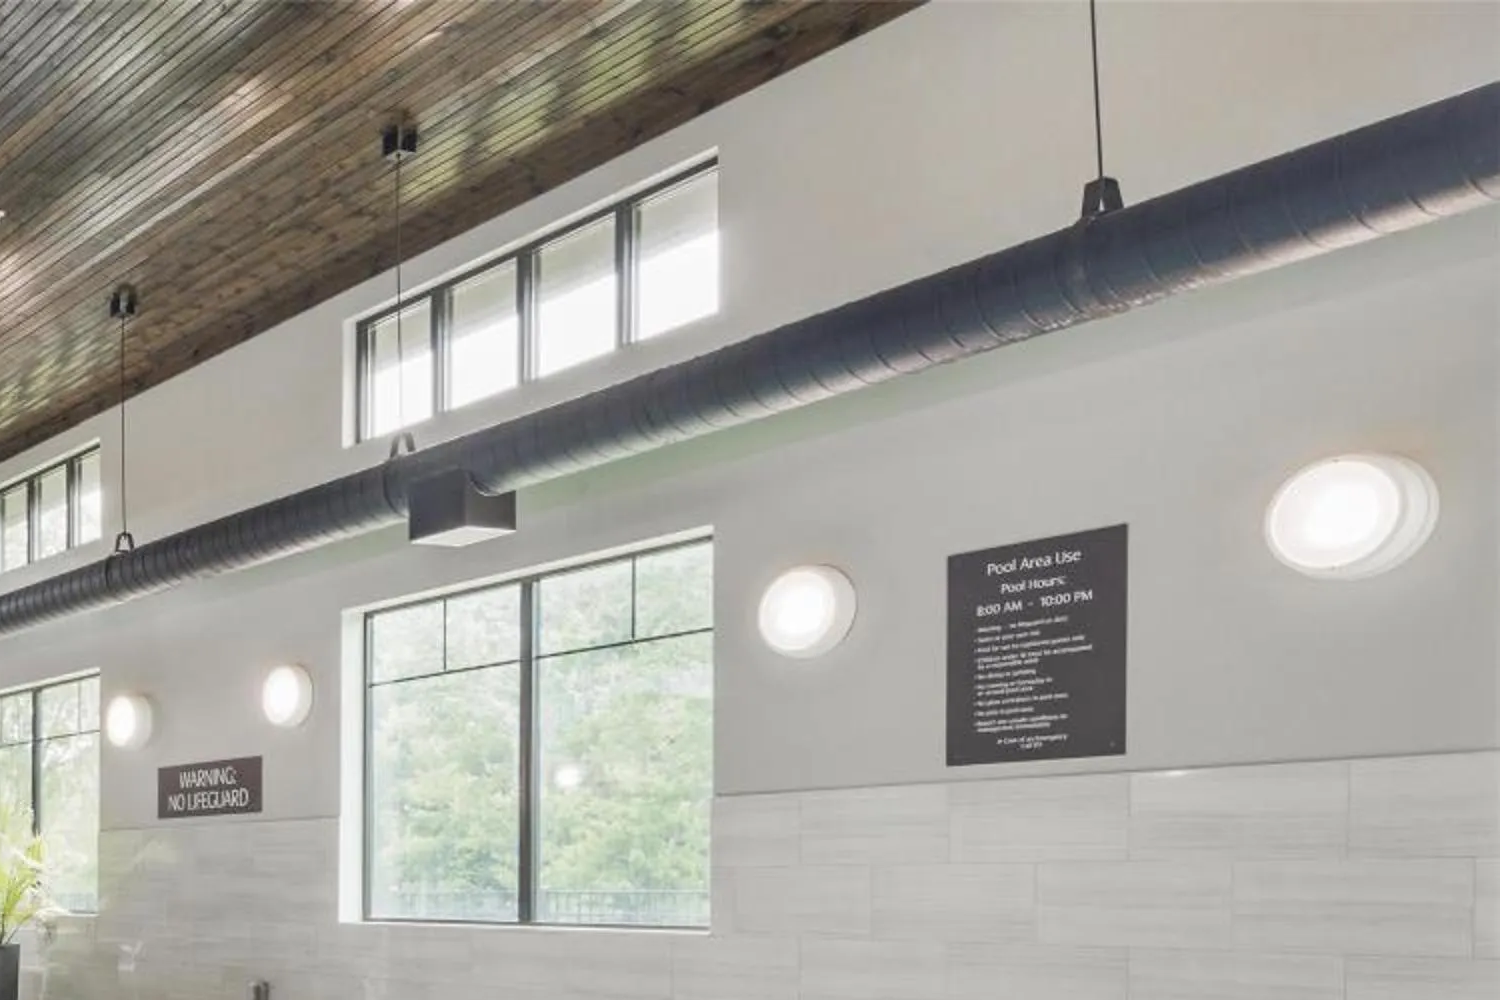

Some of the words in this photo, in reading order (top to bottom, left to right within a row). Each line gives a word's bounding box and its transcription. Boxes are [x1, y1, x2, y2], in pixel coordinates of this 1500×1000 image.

[987, 559, 1017, 576] Pool
[1020, 556, 1052, 571] Area
[1055, 550, 1082, 565] Use
[1001, 580, 1026, 595] Pool
[976, 603, 1001, 617] 8:00
[1003, 601, 1023, 613] AM
[1041, 592, 1072, 607] 10:00
[1073, 589, 1093, 602] PM
[167, 793, 185, 811] NO
[187, 787, 249, 811] LIFEGUARD
